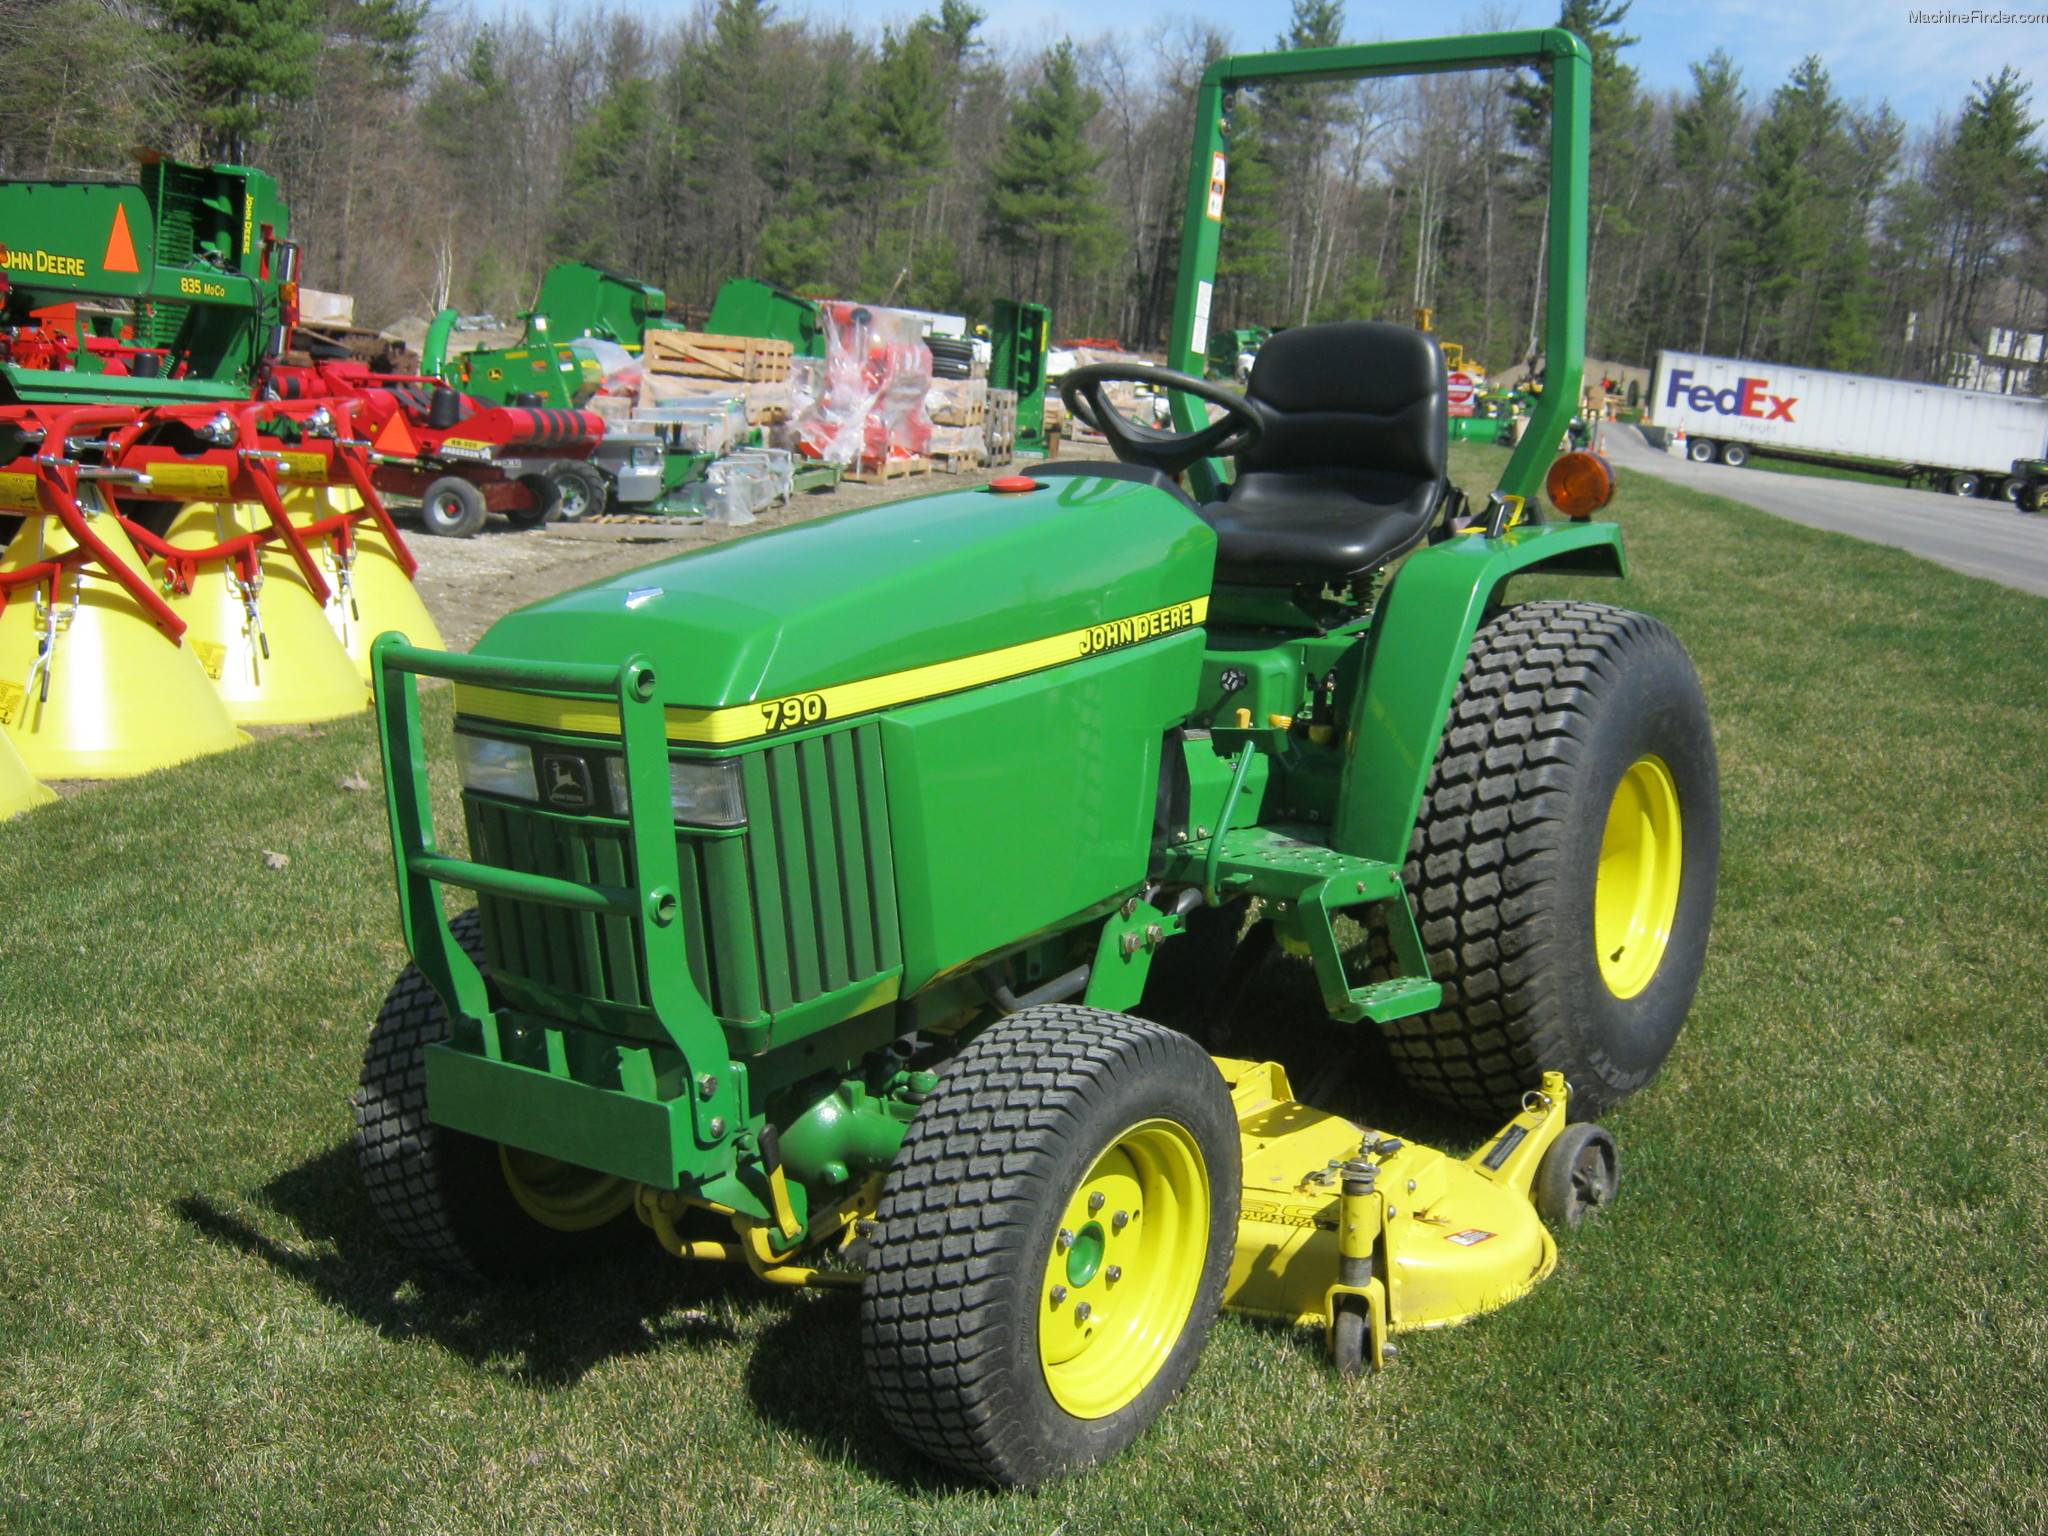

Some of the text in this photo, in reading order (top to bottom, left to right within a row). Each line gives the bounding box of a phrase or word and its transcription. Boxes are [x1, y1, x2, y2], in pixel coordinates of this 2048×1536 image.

[242, 193, 255, 255] JOHN DEERE
[0, 249, 86, 277] OHN DEERE
[181, 277, 226, 298] 835 MoCo
[1666, 368, 1799, 423] FedEx
[1079, 603, 1192, 655] JOHN DEERE
[761, 693, 827, 734] 790
